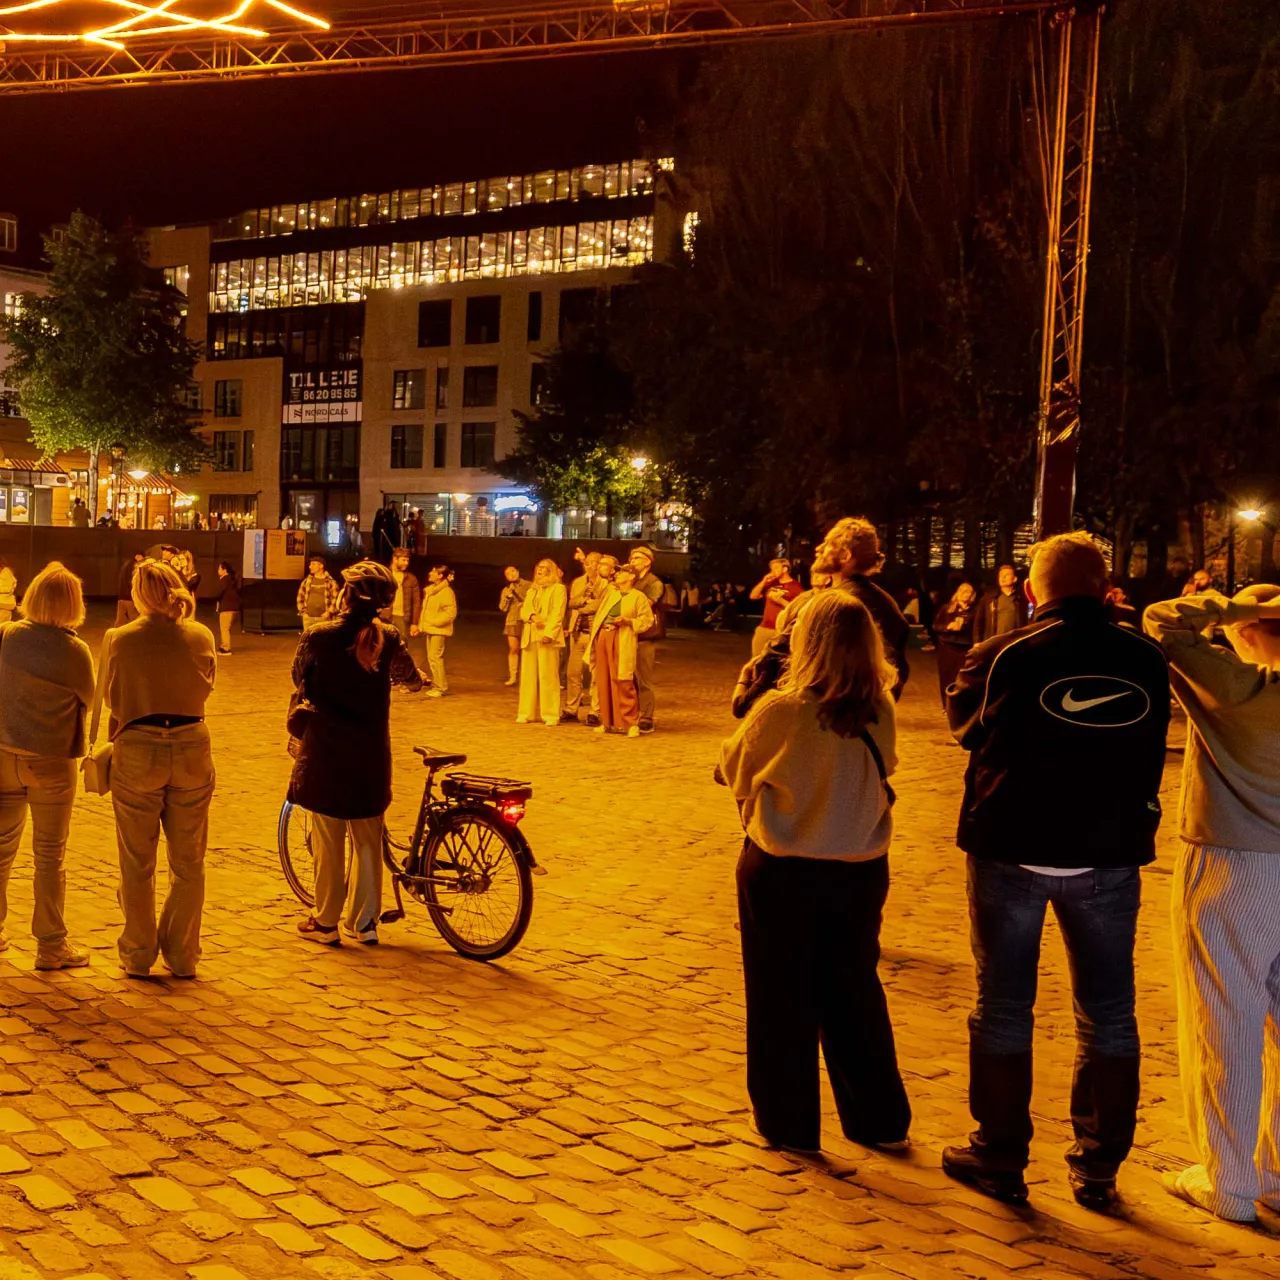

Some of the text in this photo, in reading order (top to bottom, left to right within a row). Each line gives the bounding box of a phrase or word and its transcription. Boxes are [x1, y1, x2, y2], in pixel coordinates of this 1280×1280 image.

[289, 370, 358, 388] TIL LEJE
[316, 389, 329, 400] 20
[305, 408, 349, 417] NORDCALS
